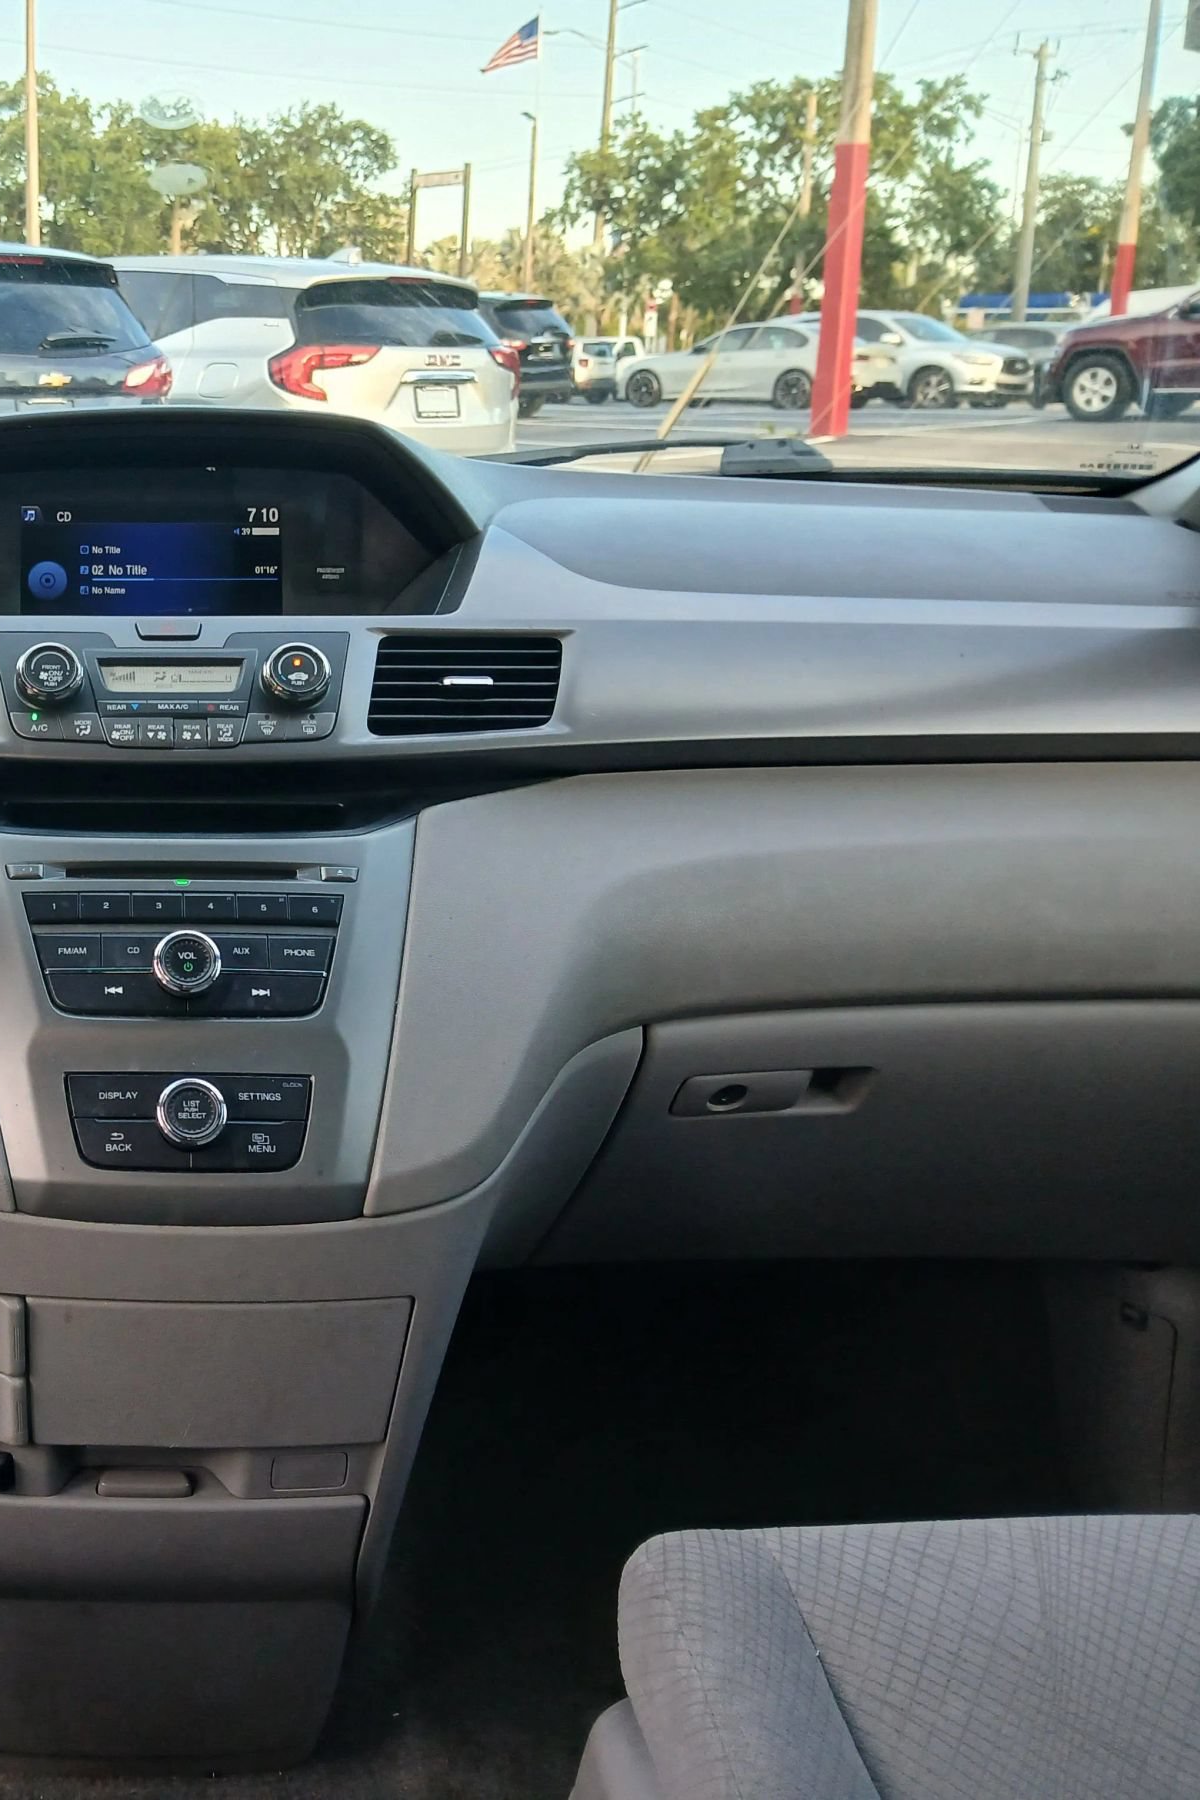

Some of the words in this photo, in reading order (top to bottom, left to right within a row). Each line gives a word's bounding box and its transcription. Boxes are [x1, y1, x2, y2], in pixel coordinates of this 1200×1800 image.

[56, 511, 72, 522] CD
[92, 545, 103, 554] No
[105, 545, 121, 554] Title
[91, 564, 104, 576] 02
[108, 564, 124, 576] No
[125, 564, 148, 576] Title
[92, 586, 103, 594] No
[104, 586, 126, 595] Name
[175, 703, 189, 711] A/C
[30, 724, 48, 732] A/C
[207, 902, 214, 910] 4
[260, 904, 267, 912] 5
[311, 906, 319, 914] 6
[57, 947, 87, 955] FM/AM
[127, 946, 140, 954] CD
[233, 947, 250, 955] AUX
[283, 948, 316, 957] PHONE
[177, 951, 198, 960] VOL
[98, 1091, 138, 1100] DISPLAY
[238, 1092, 282, 1101] SETTINGS
[182, 1100, 201, 1108] LIST
[105, 1143, 133, 1152] BACK
[248, 1144, 276, 1153] MENU
